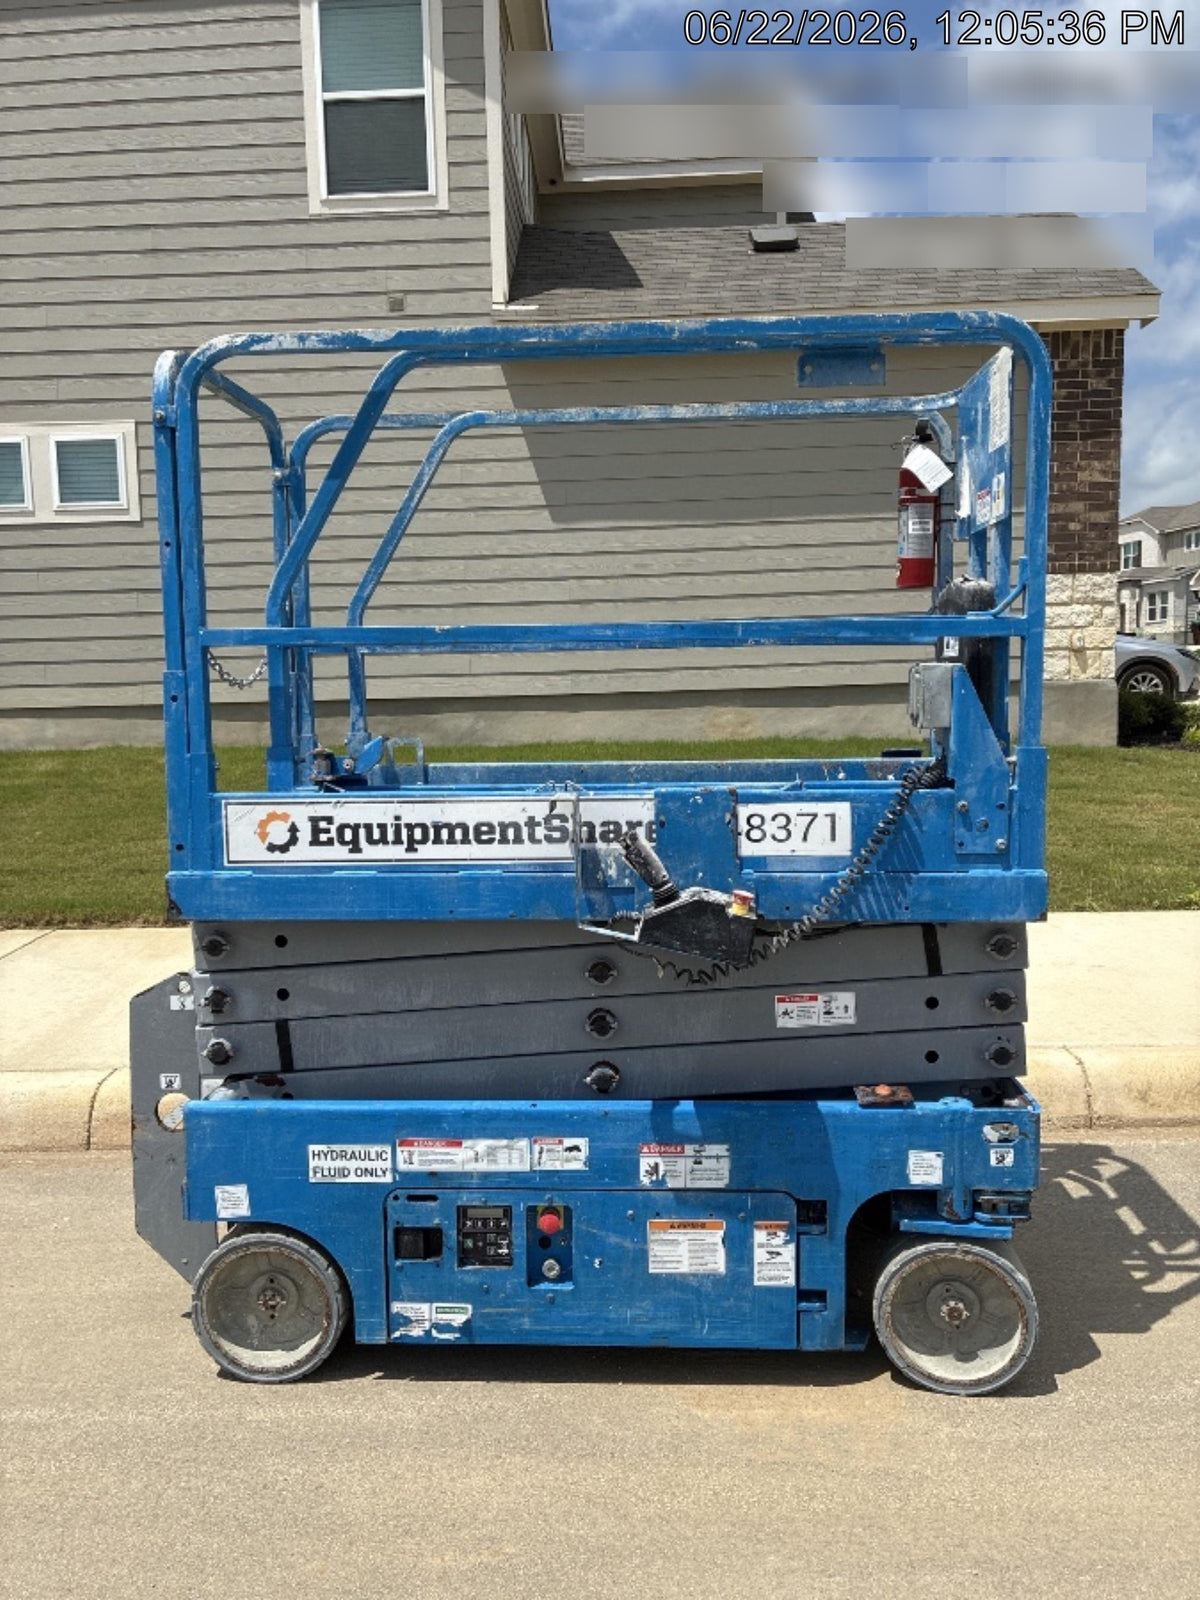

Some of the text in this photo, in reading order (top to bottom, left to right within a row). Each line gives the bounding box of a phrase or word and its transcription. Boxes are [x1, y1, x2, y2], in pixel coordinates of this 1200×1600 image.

[737, 813, 836, 843] 8371
[312, 1149, 389, 1161] HYDRAULIC
[312, 1166, 388, 1178] FLUID ONLY
